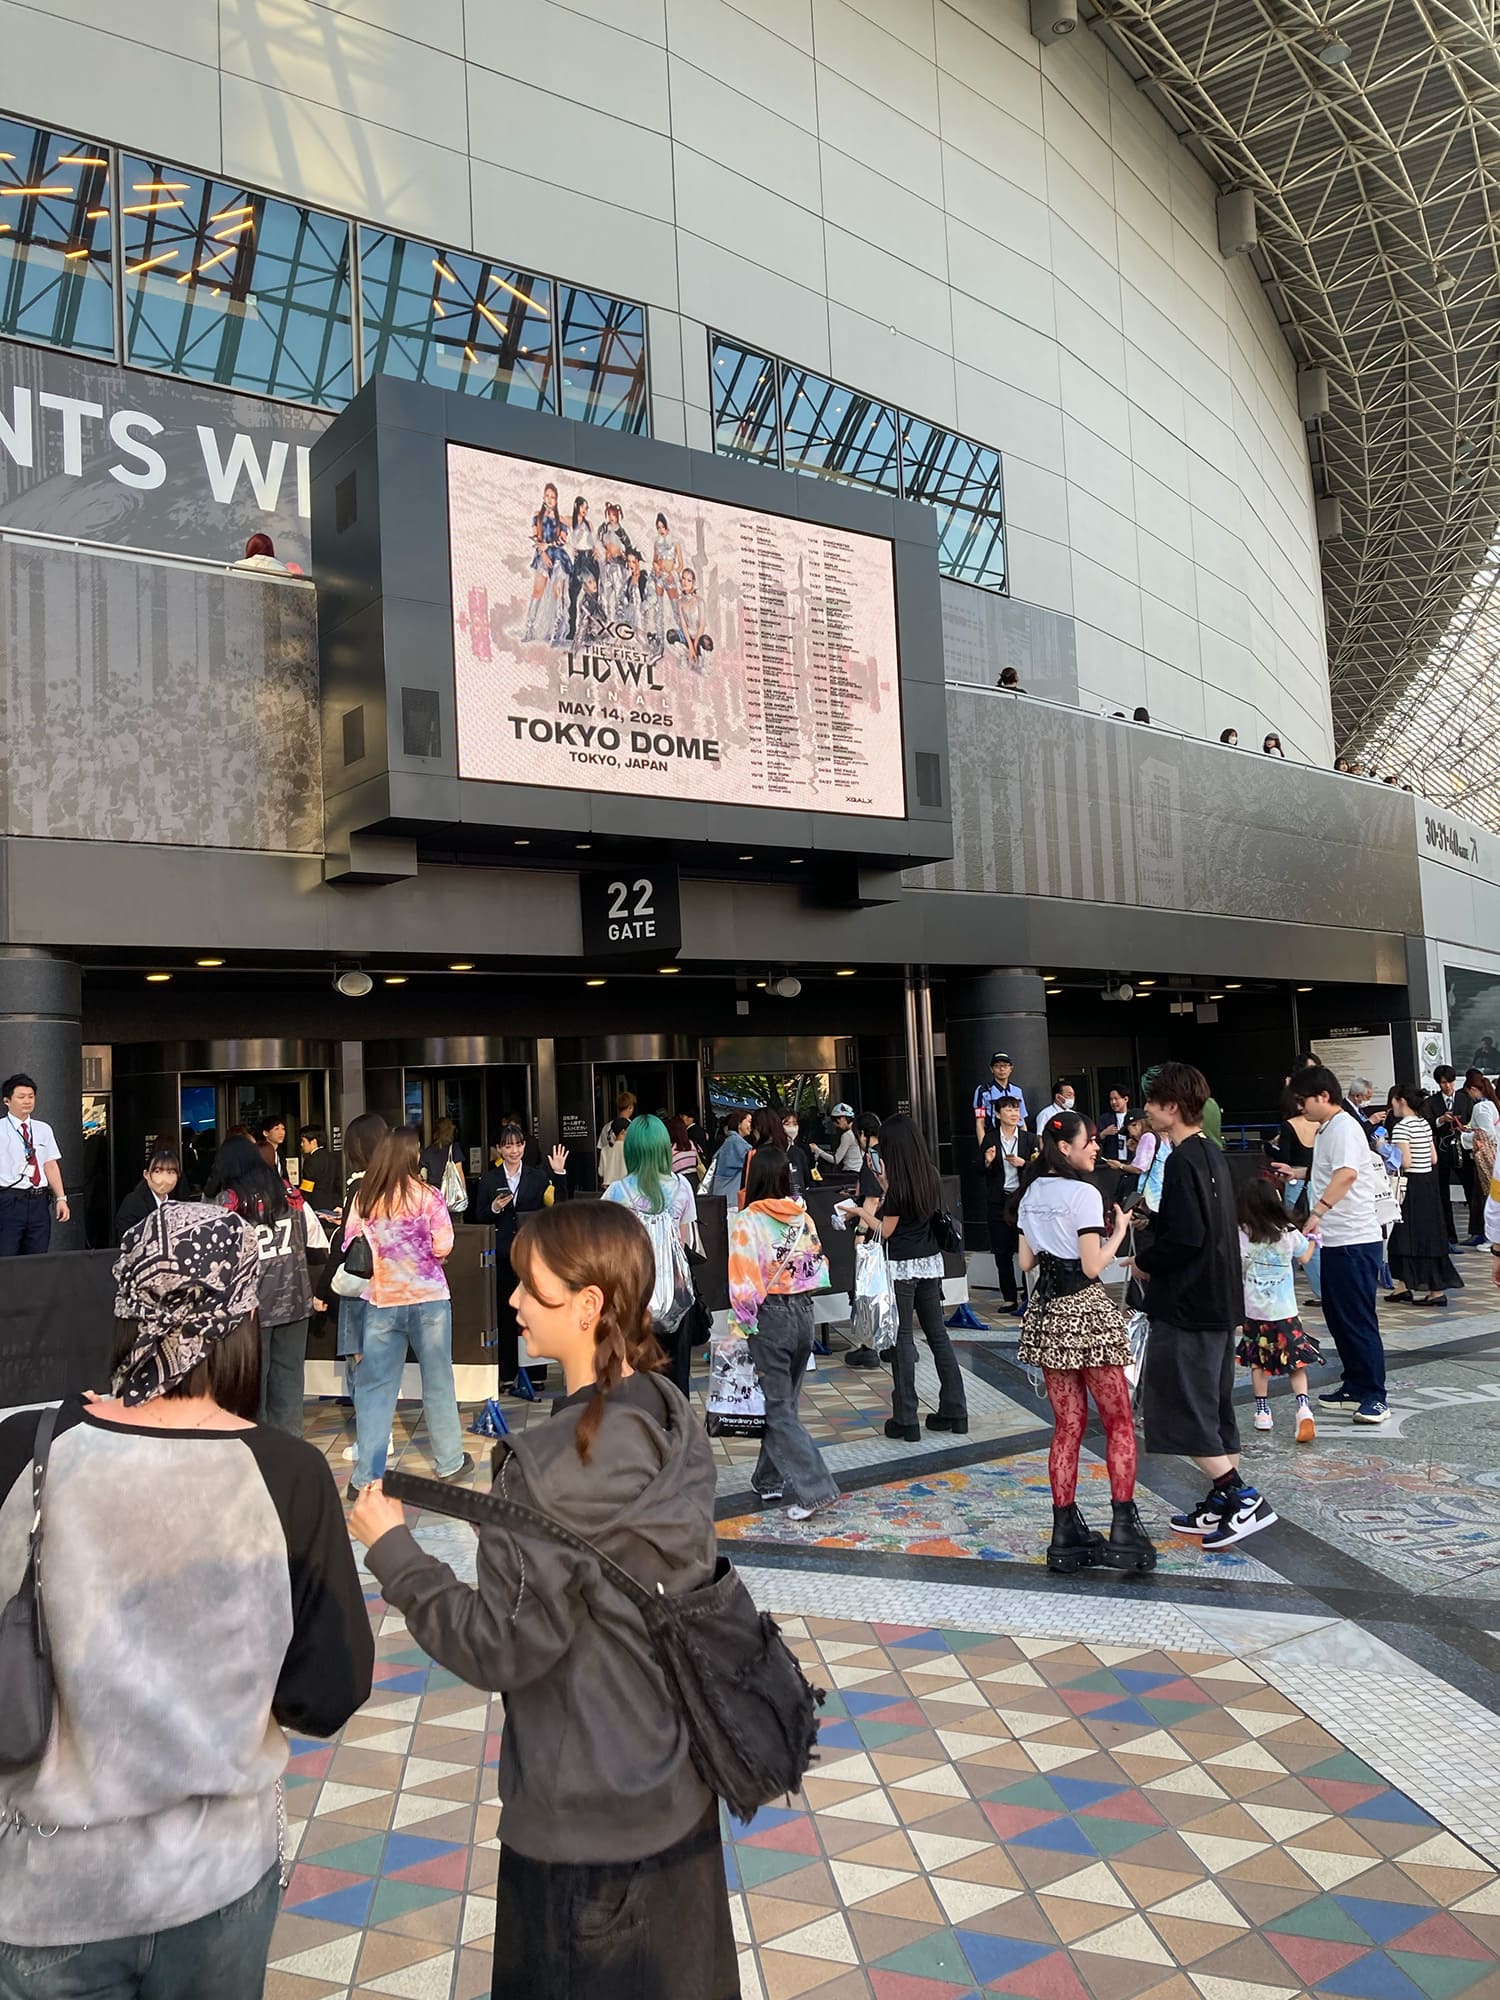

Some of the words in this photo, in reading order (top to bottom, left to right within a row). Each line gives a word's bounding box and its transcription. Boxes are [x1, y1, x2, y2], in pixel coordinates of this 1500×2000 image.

[597, 620, 635, 640] XG
[584, 645, 606, 657] THE
[613, 649, 649, 663] FIRST
[558, 701, 596, 717] MAY
[600, 707, 625, 724] 14,
[630, 711, 673, 727] 2025
[507, 715, 620, 751] TOKYO
[631, 731, 720, 762] DOME
[569, 751, 621, 769] TOKYO,
[625, 757, 668, 772] JAPAN
[608, 879, 654, 919] 22
[608, 920, 656, 940] GATE
[255, 1218, 292, 1260] 27
